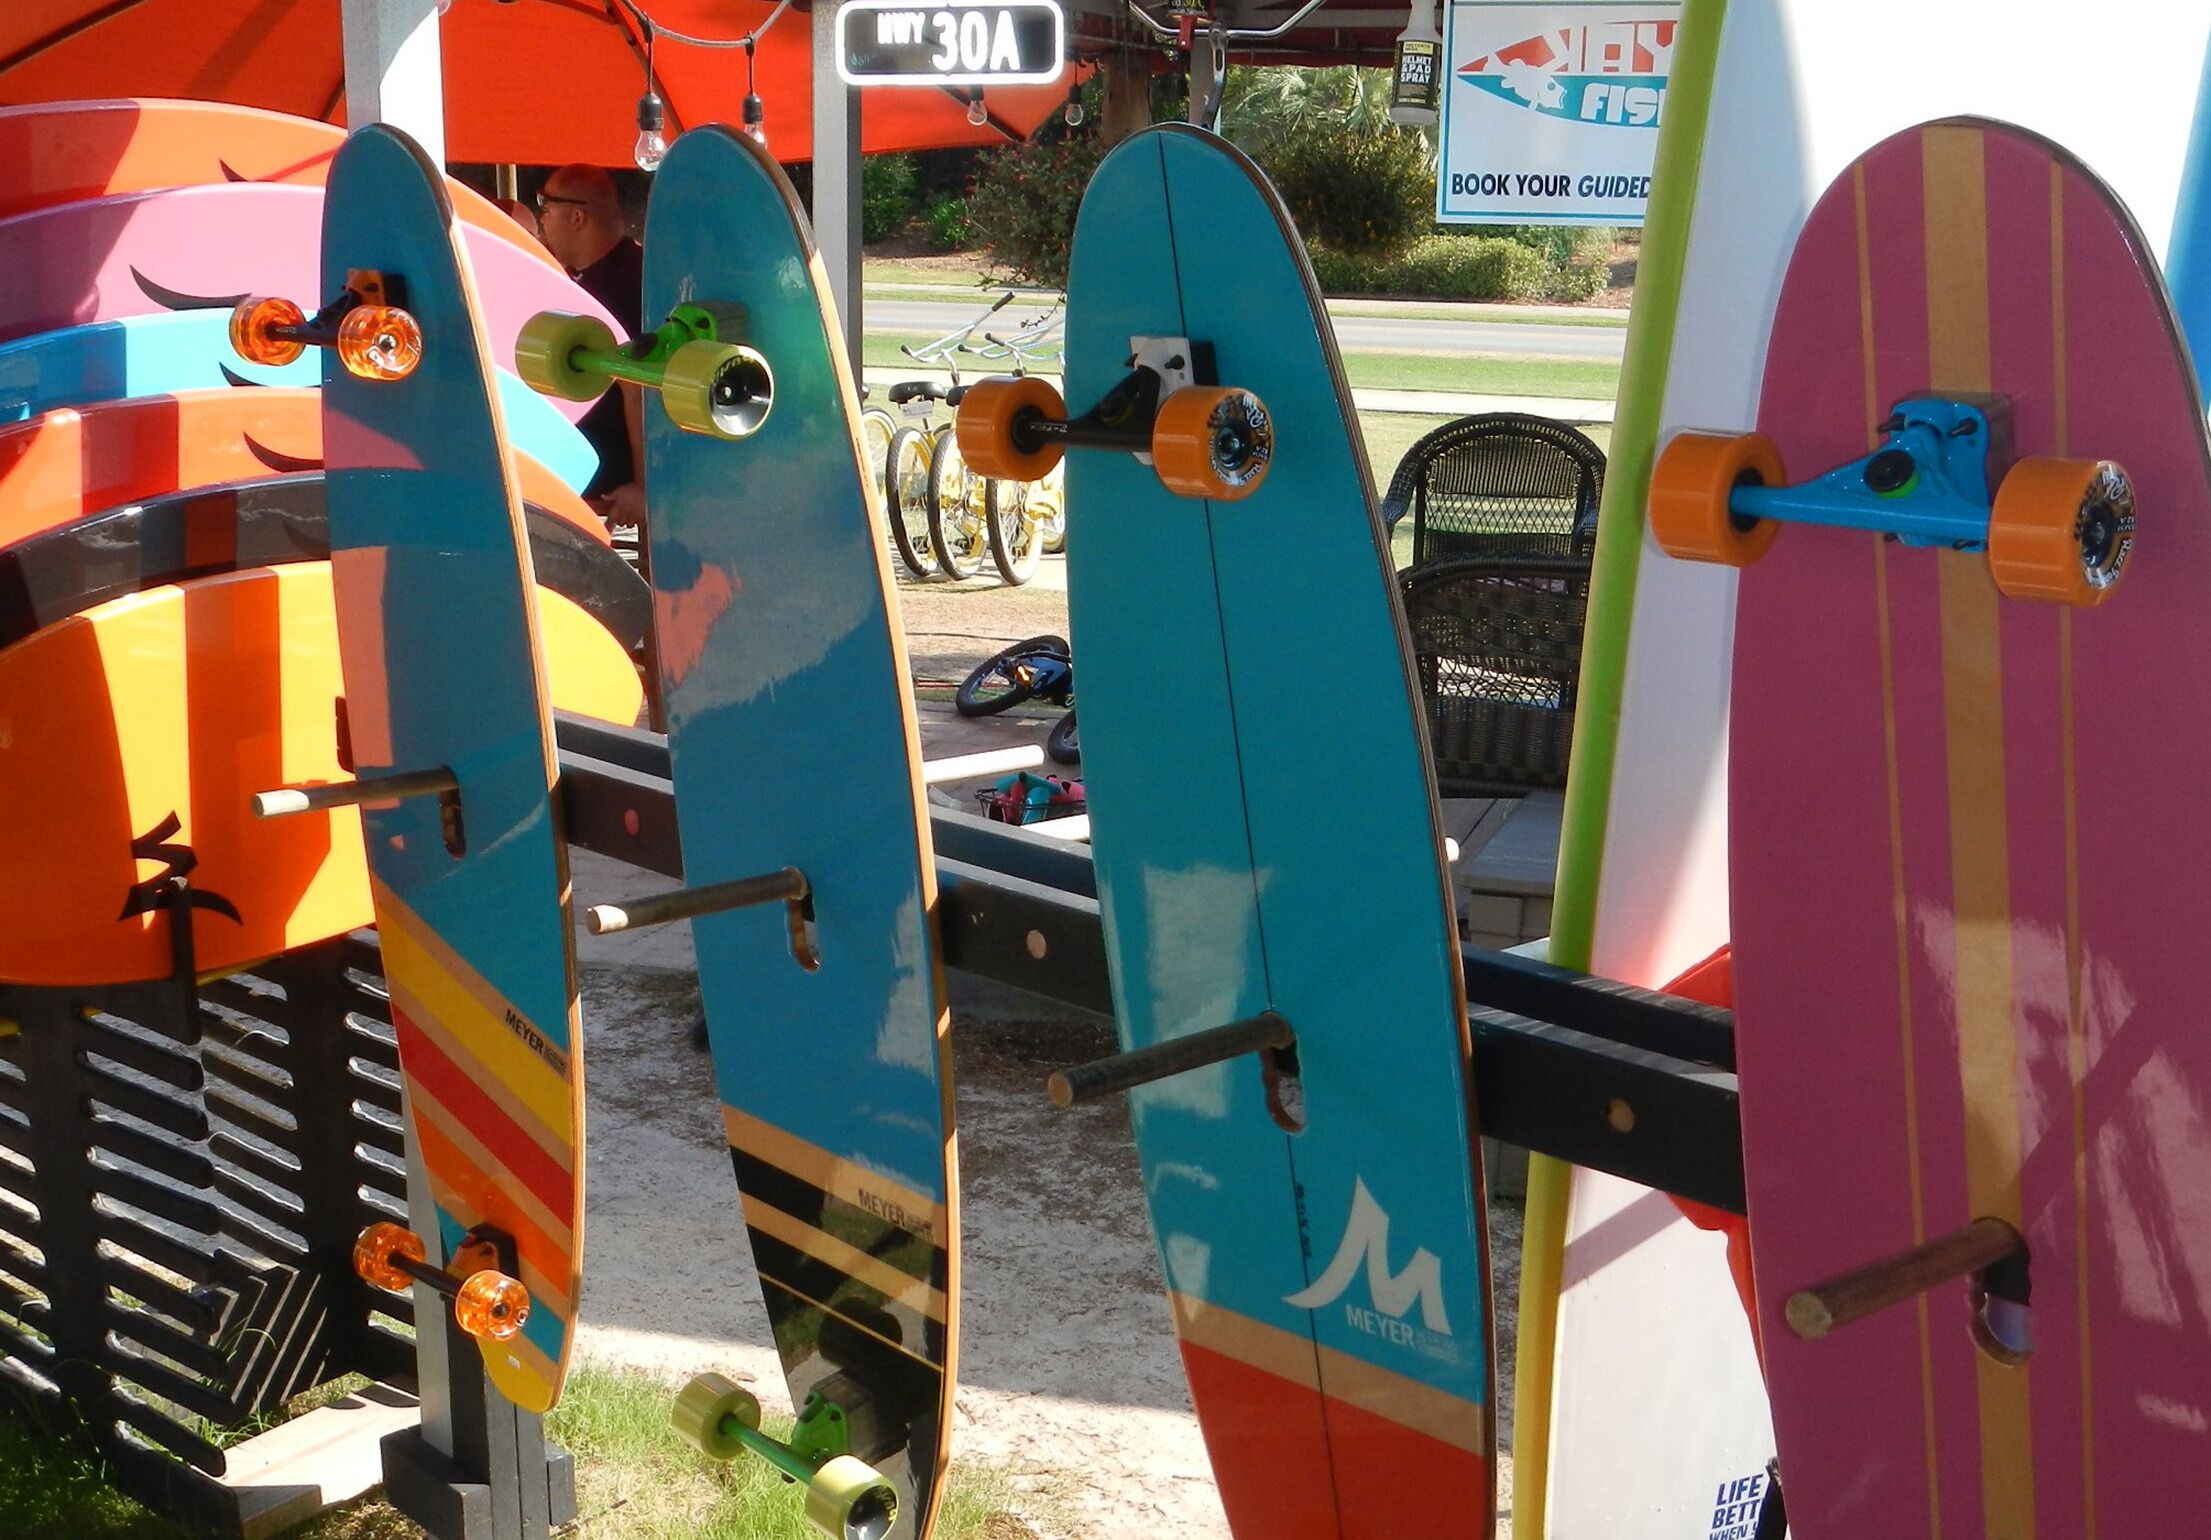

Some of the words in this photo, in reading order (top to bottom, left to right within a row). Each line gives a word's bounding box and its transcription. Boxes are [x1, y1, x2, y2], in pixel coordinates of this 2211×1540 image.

[931, 10, 1020, 71] 30A
[1400, 72, 1431, 84] SPRAY
[1402, 55, 1432, 65] HELMET
[1451, 173, 1511, 196] BOOK
[1515, 174, 1571, 197] YOUR
[1577, 175, 1652, 199] GUIDED
[505, 1008, 545, 1055] MEYER
[858, 1187, 906, 1228] MEYER
[1345, 1303, 1415, 1349] MEYER
[1716, 1473, 1764, 1506] LIFE
